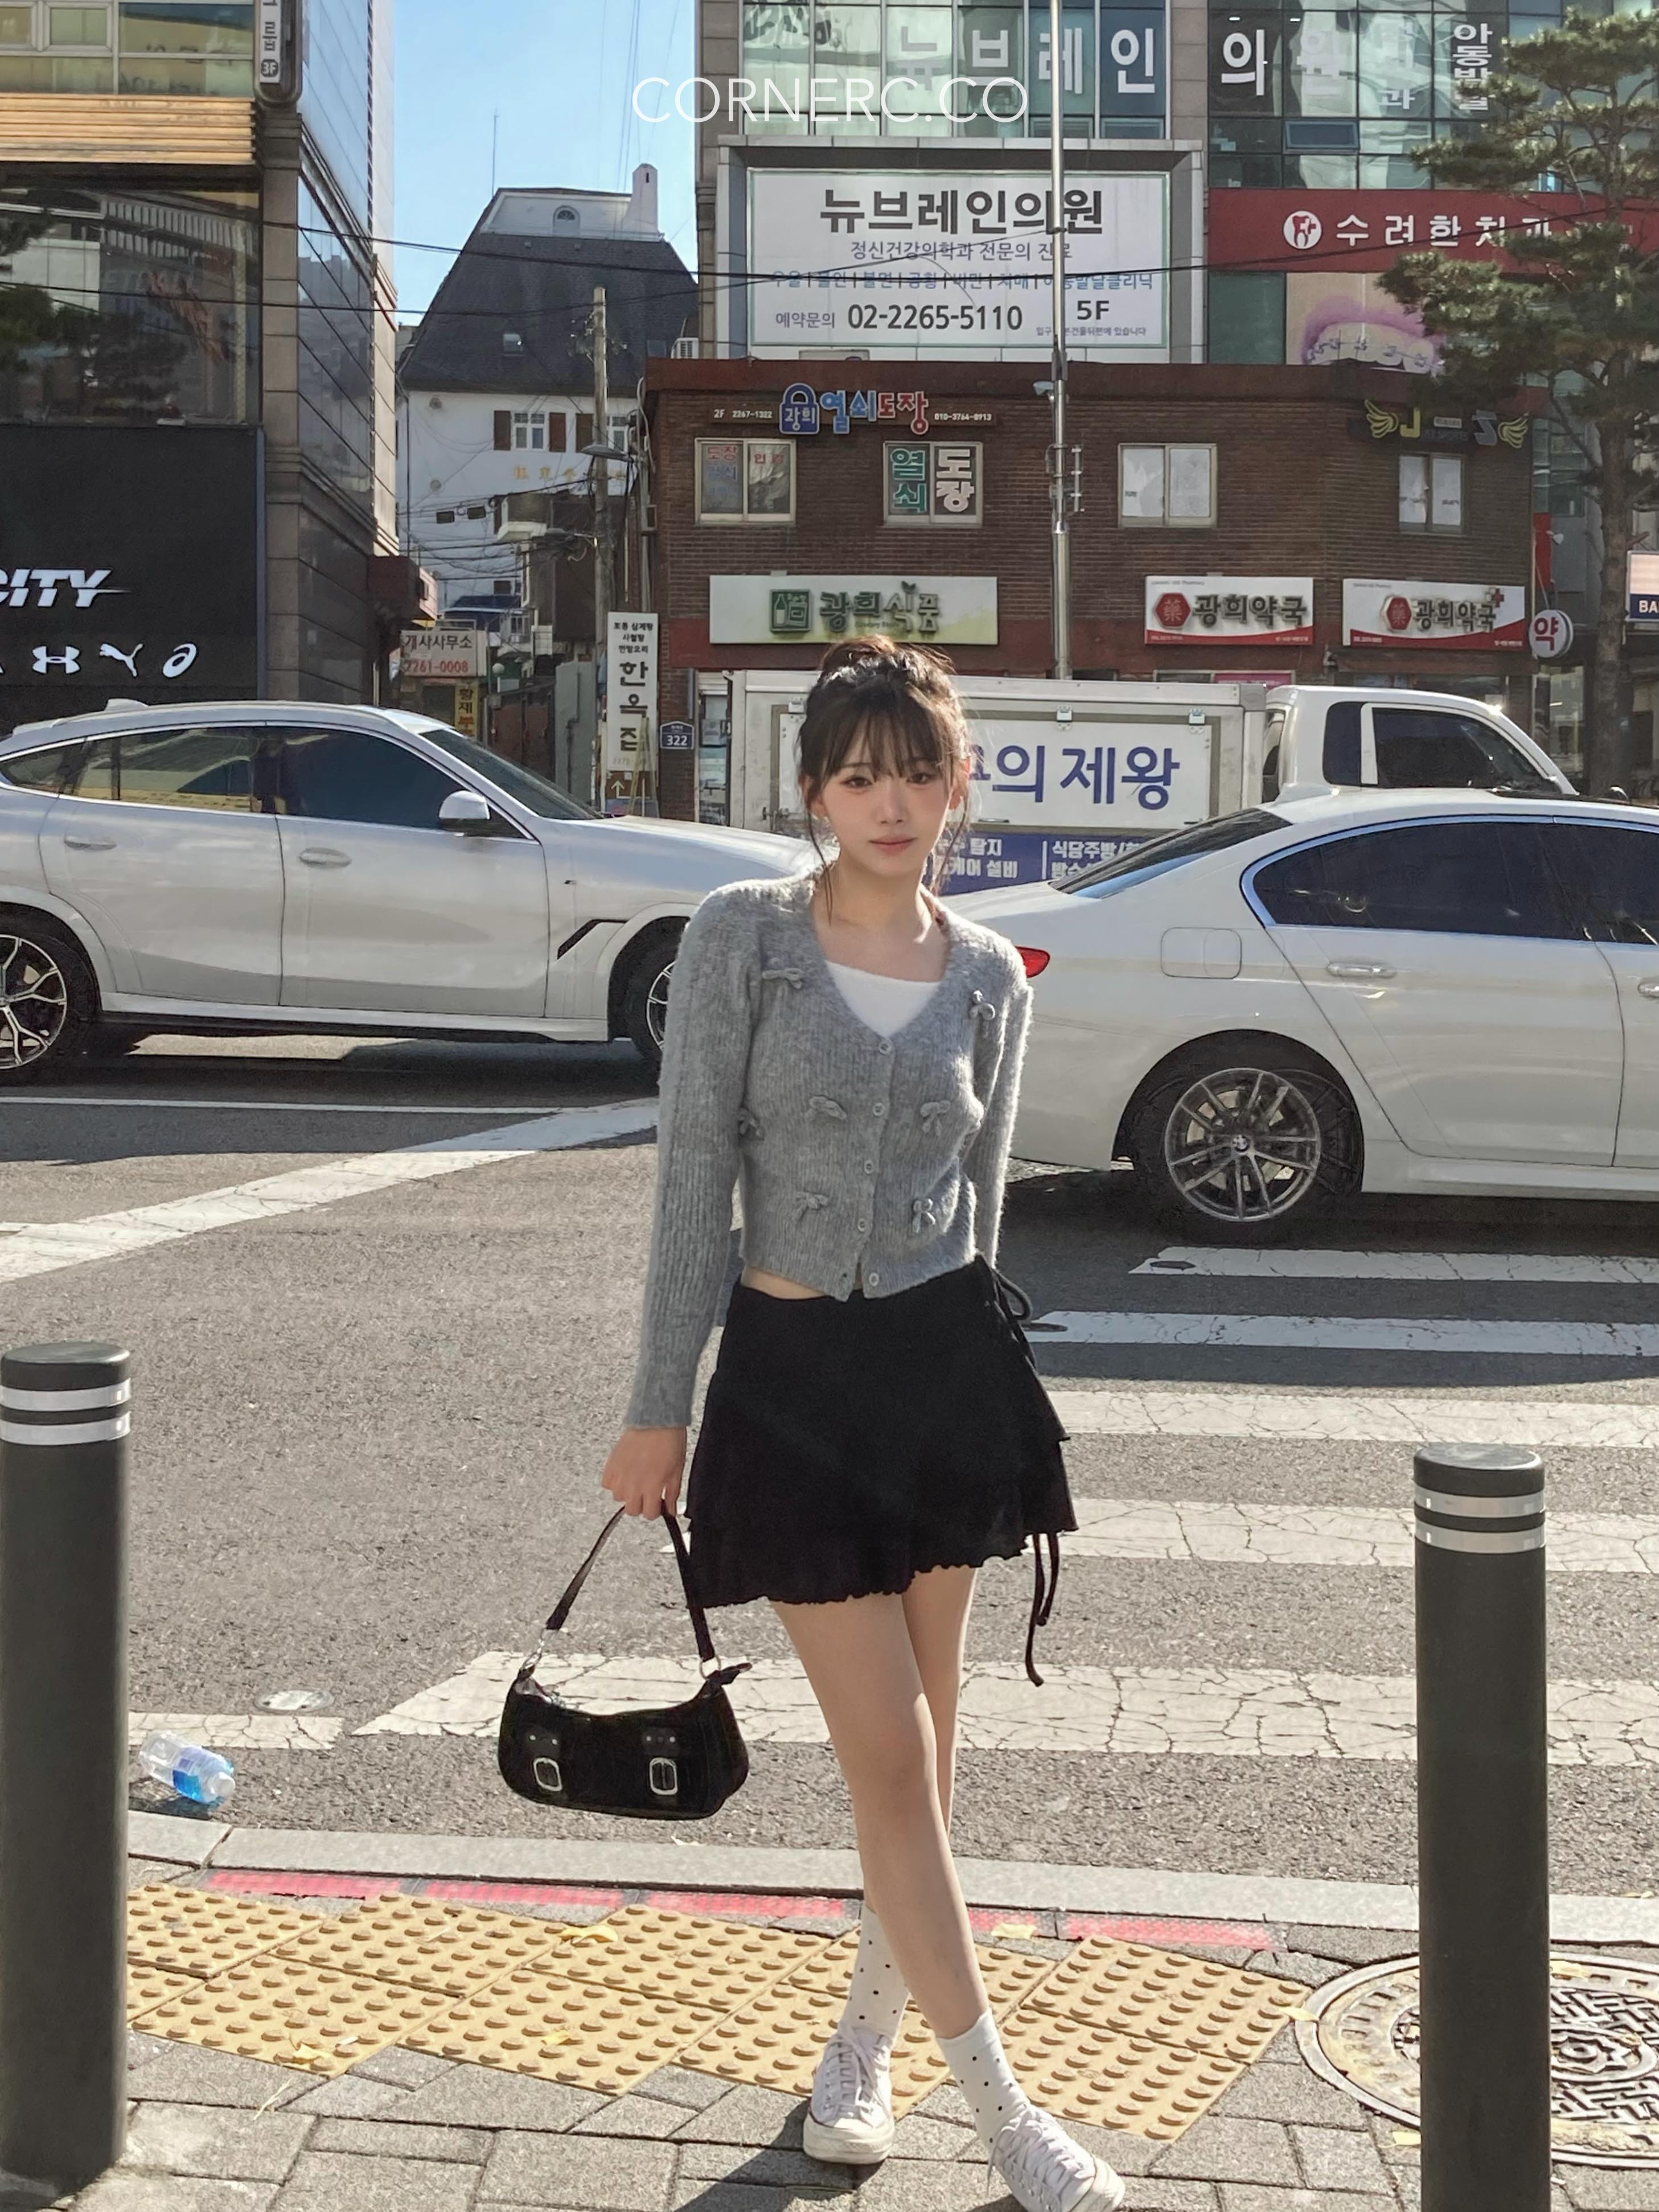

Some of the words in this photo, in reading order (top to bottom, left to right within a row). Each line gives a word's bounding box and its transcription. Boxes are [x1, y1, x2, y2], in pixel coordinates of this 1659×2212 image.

[262, 61, 278, 75] 3F
[820, 190, 1102, 235] 뉴브레인의원
[851, 241, 974, 261] 정신건강의학과
[980, 242, 1030, 261] 전문의
[775, 312, 836, 328] 예약문의
[848, 305, 1023, 331] 02-2265-5110
[1077, 300, 1110, 320] 5F
[891, 449, 927, 513] 열쇠
[937, 449, 975, 512] 도장
[819, 583, 939, 633] 광희식품
[1193, 594, 1307, 628] 광희약국
[1416, 601, 1496, 632] 광희약국
[1639, 600, 1659, 614] BA
[1534, 616, 1559, 651] 약
[667, 735, 688, 746] 322
[1060, 746, 1181, 811] 제왕
[970, 837, 1002, 857] 탐지
[987, 860, 1018, 879] 설비
